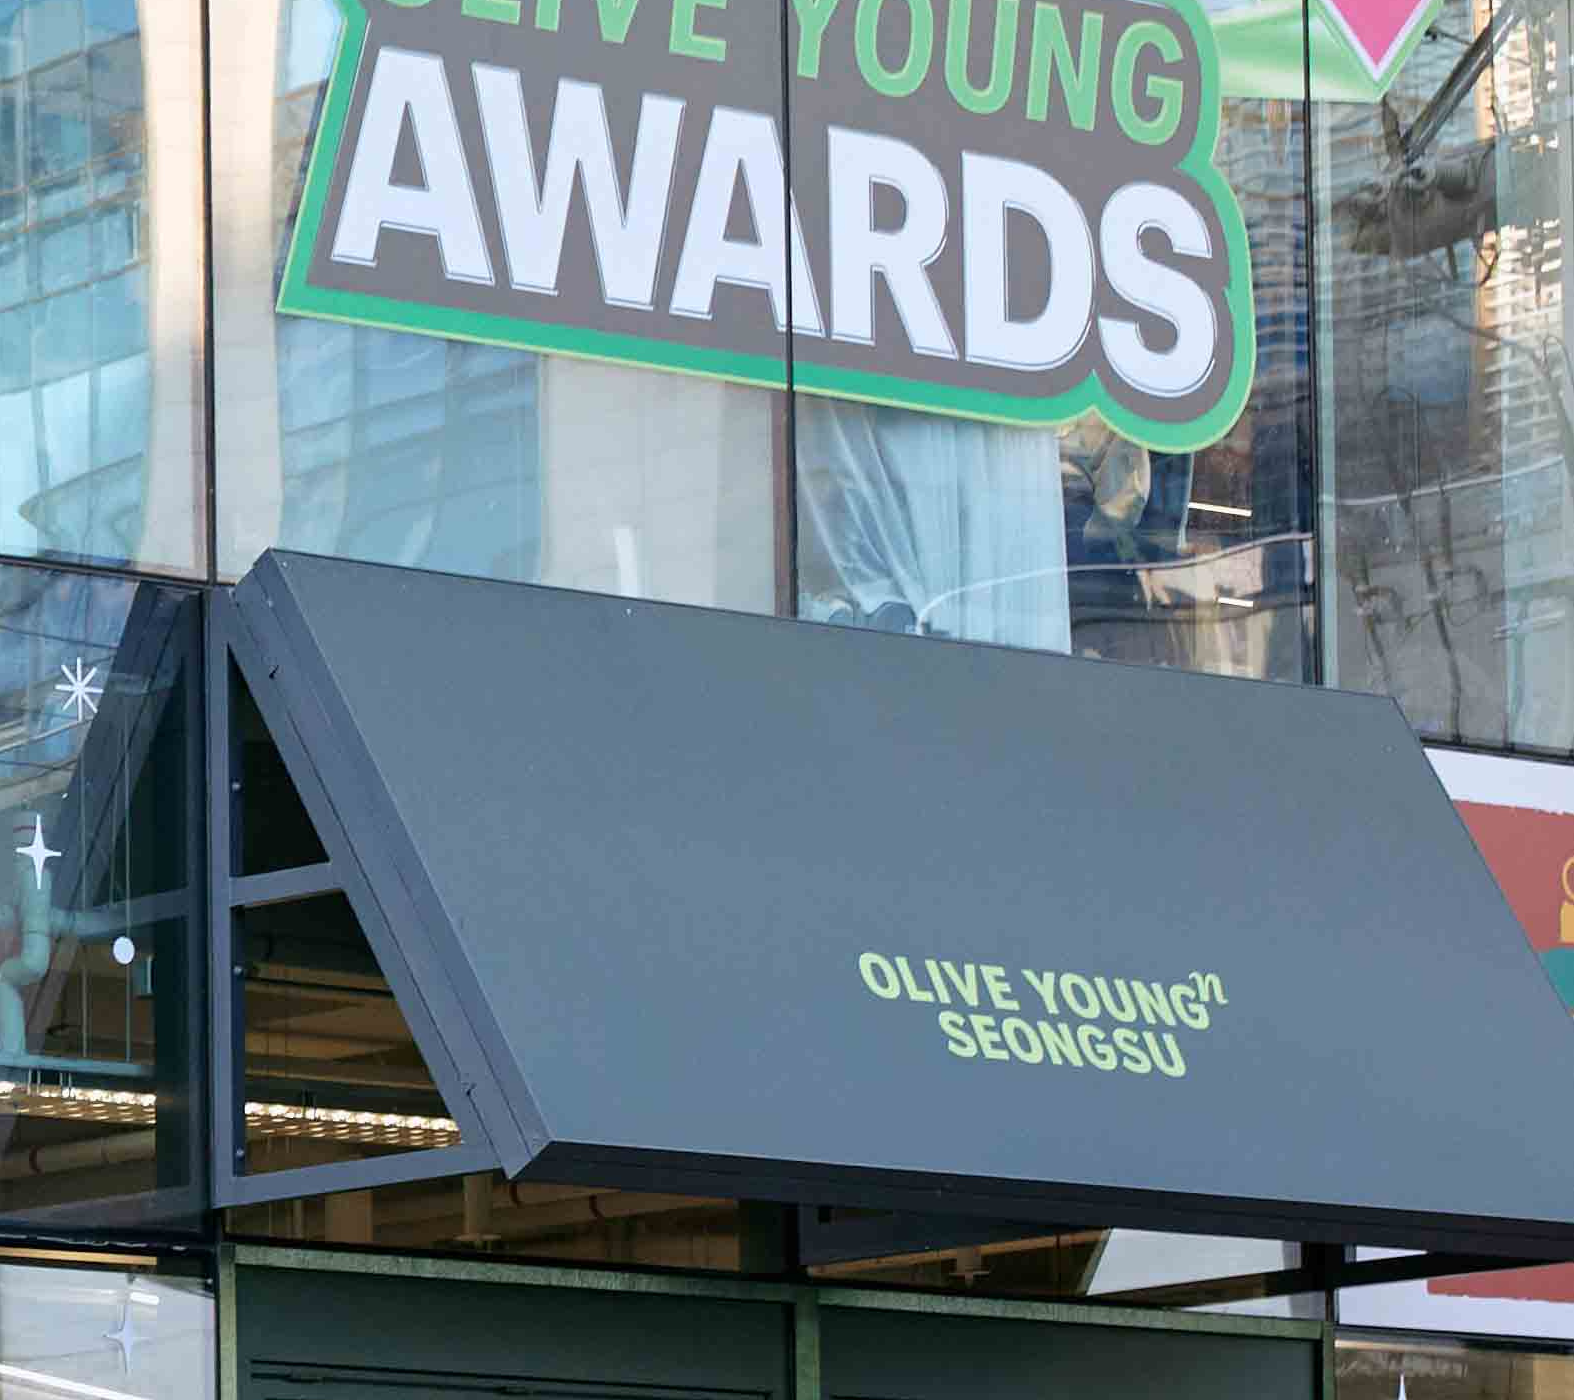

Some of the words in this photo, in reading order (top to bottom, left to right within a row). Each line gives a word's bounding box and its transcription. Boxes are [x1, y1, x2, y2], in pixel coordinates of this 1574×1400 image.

[329, 46, 1220, 400] AWARDS
[858, 951, 1021, 1012] OLIVE
[938, 1010, 1187, 1078] SEONGSU
